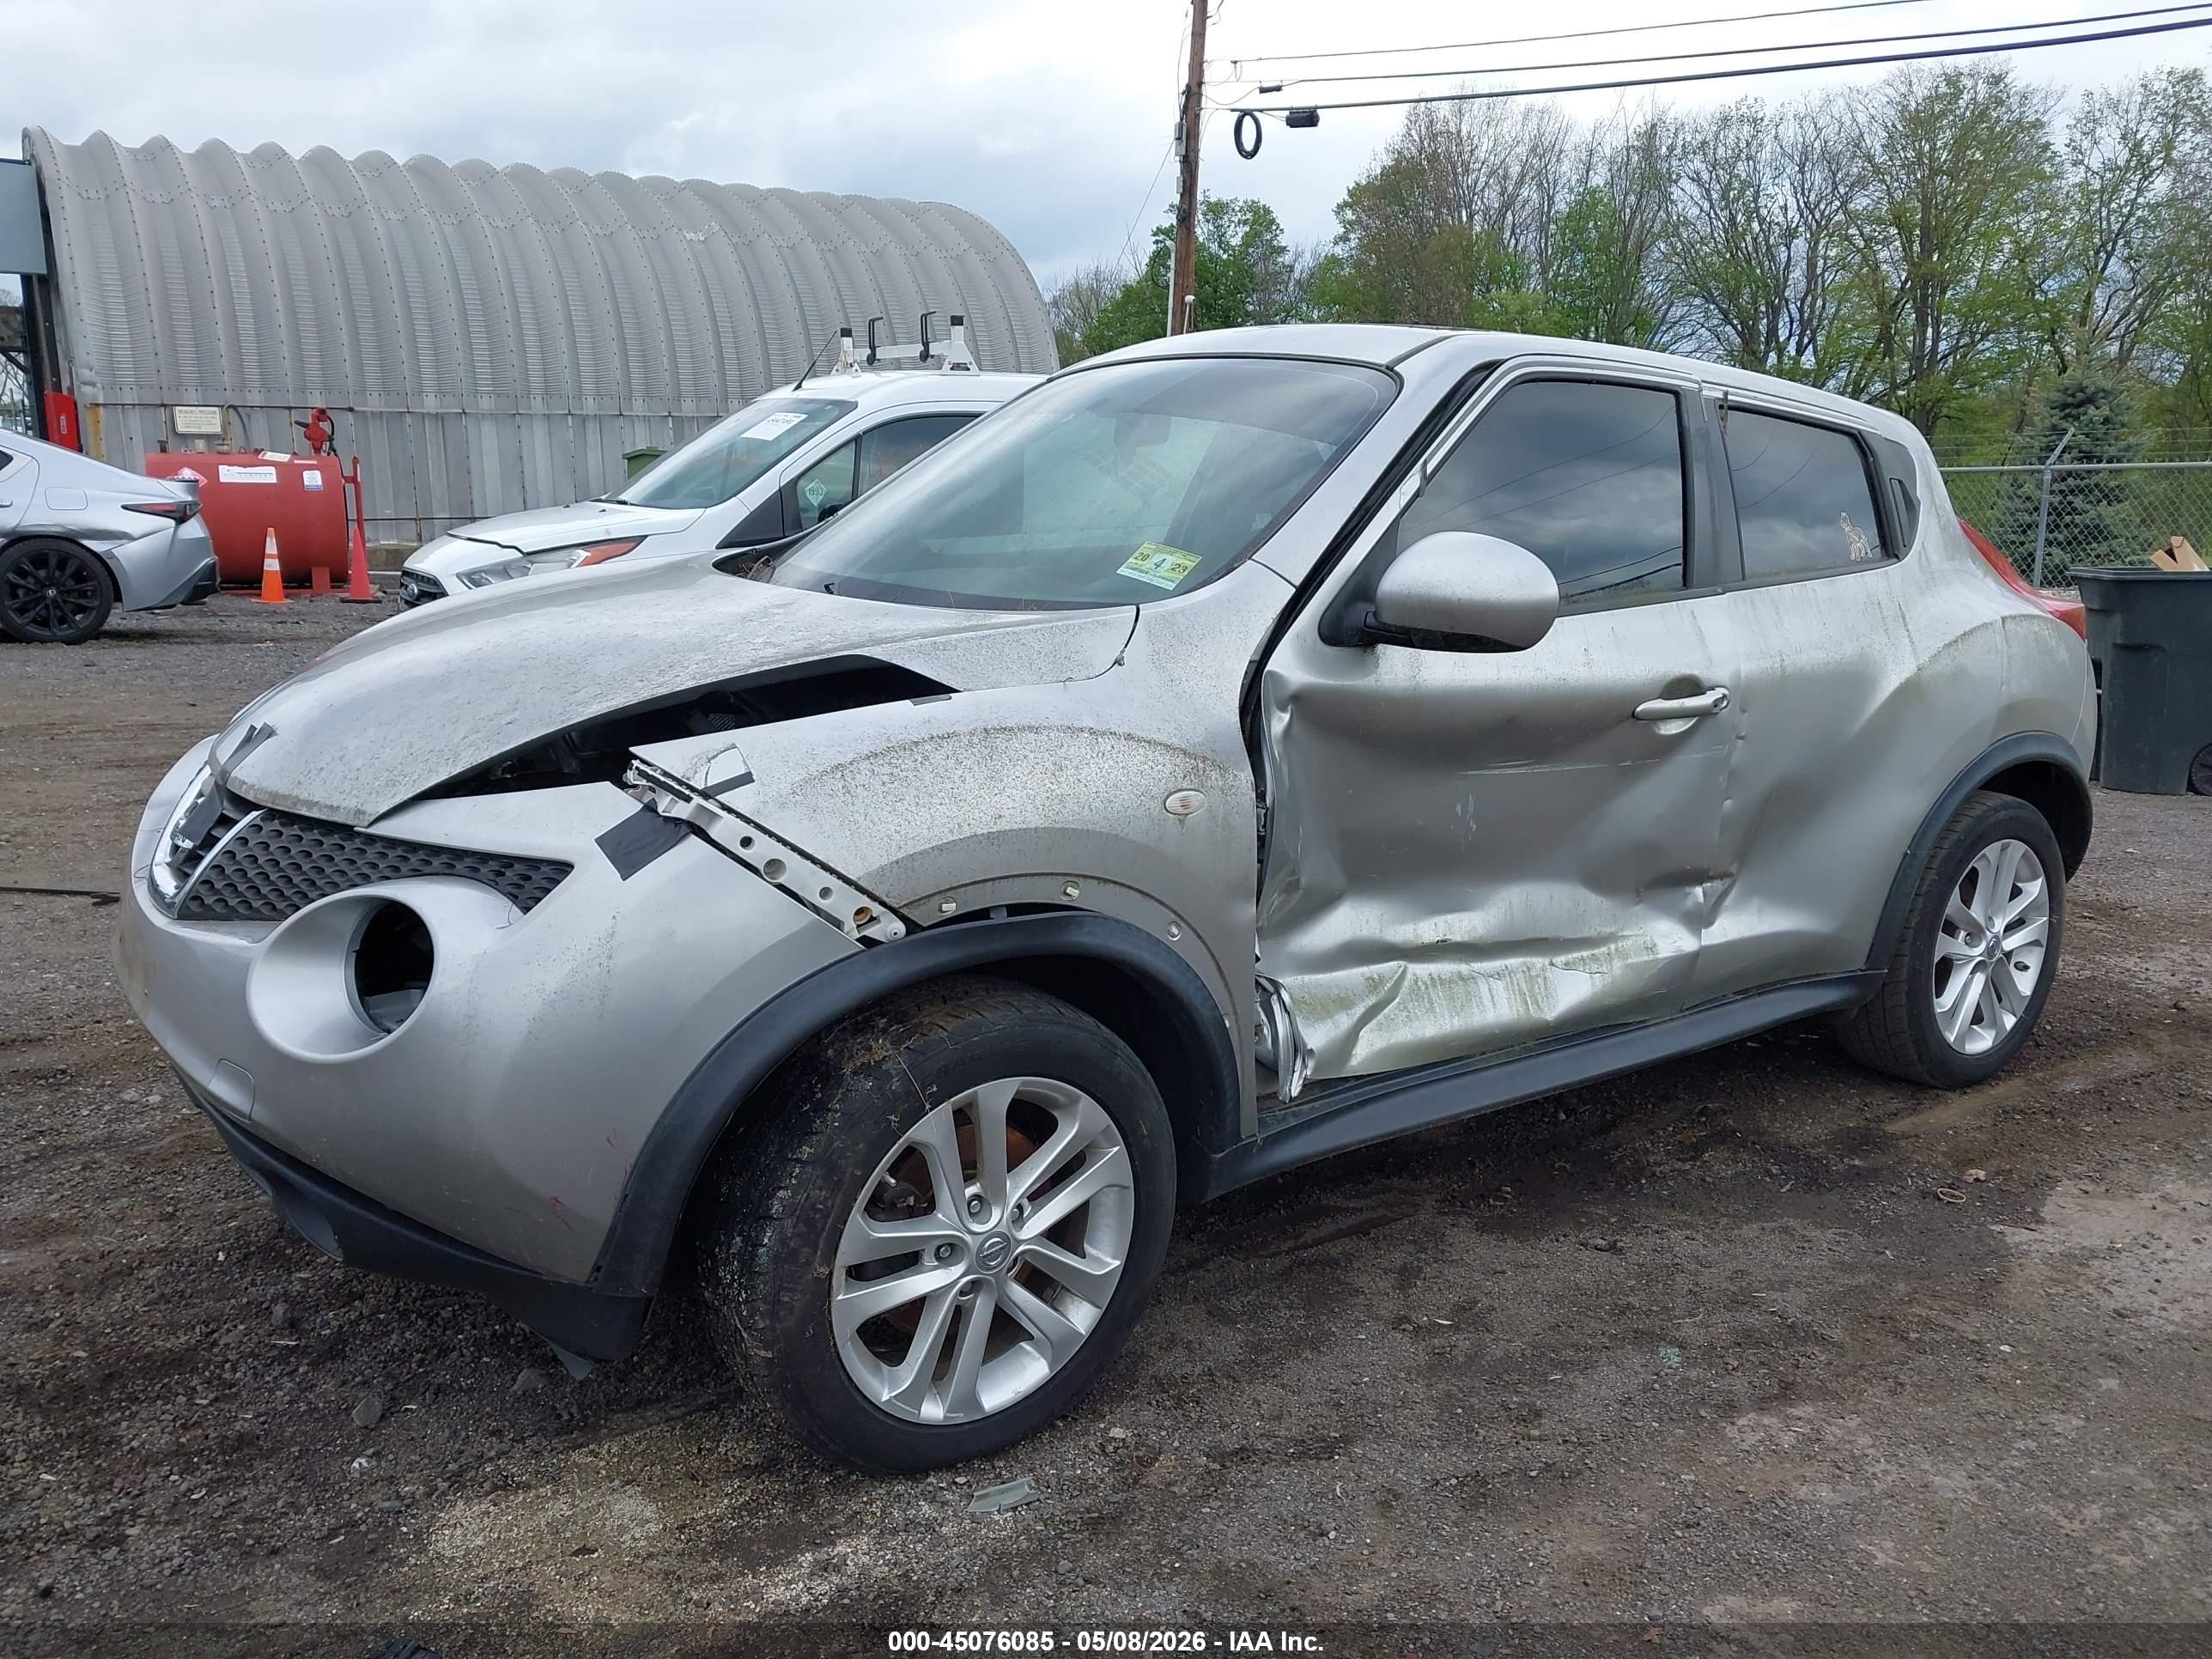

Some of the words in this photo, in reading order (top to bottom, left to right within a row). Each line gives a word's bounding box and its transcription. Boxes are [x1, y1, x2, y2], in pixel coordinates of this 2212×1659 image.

[808, 487, 824, 495] 1993
[1133, 552, 1151, 562] 20
[1153, 558, 1167, 569] 4
[1170, 563, 1188, 574] 23
